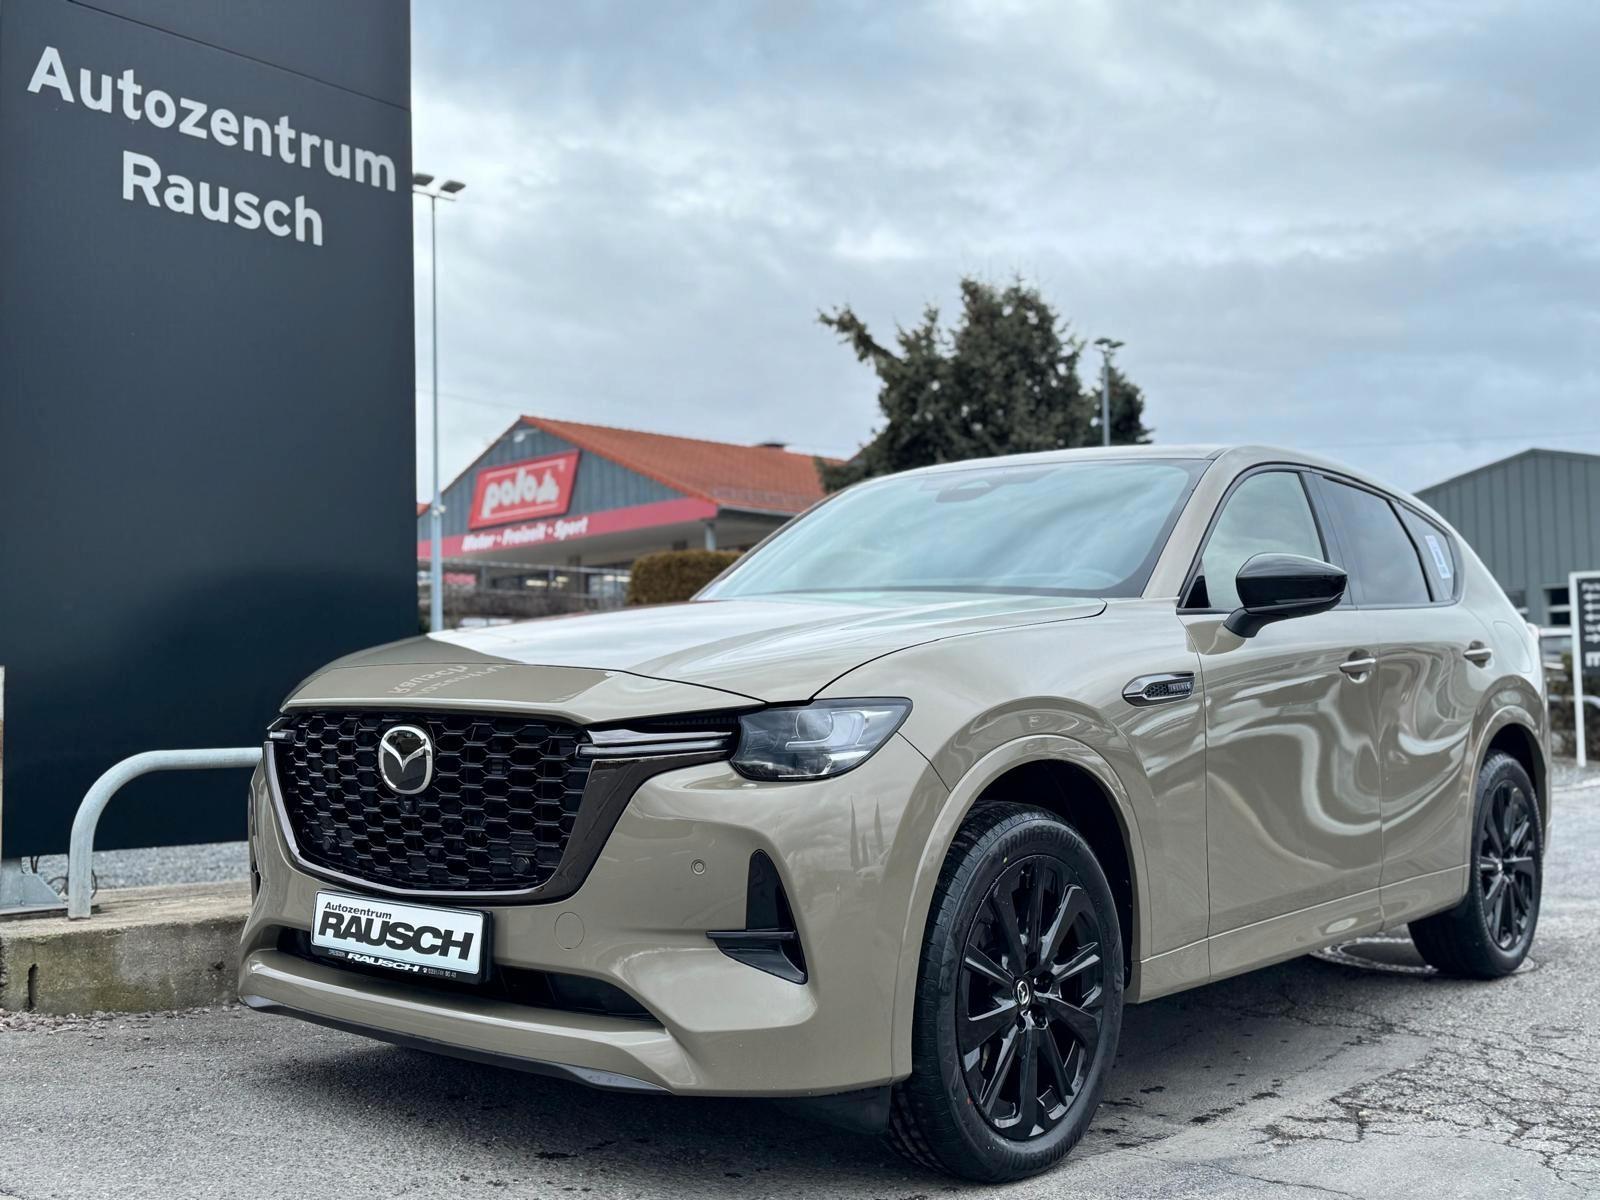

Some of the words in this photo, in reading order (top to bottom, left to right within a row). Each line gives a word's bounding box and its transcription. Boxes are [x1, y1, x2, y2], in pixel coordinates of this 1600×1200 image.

[27, 46, 397, 192] Autozentrum
[122, 150, 323, 246] Rausch
[481, 467, 538, 519] polo
[318, 910, 474, 961] RAUSCH
[324, 901, 392, 920] Autozentrum
[347, 953, 420, 973] RAUSCH
